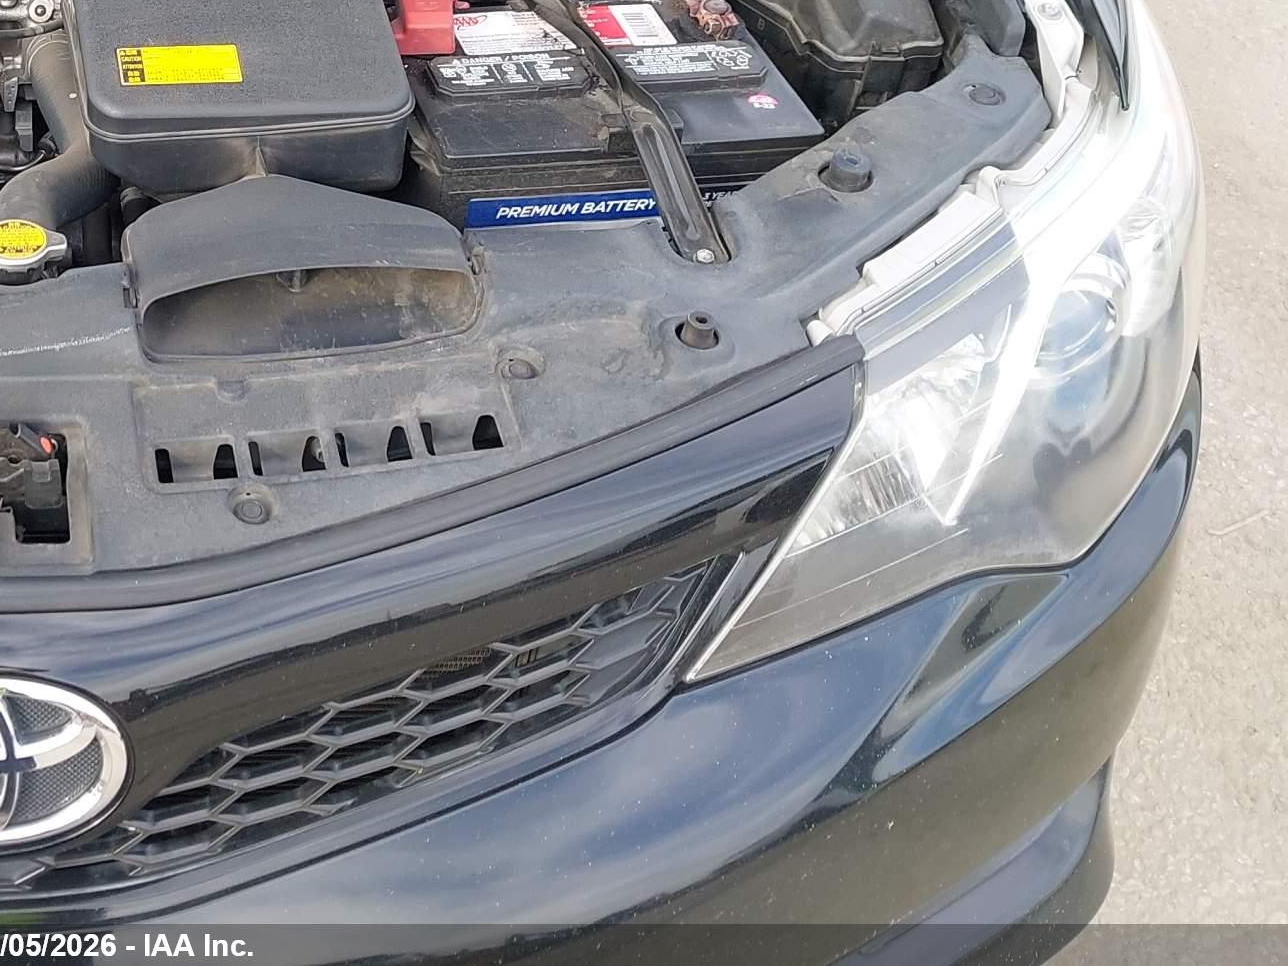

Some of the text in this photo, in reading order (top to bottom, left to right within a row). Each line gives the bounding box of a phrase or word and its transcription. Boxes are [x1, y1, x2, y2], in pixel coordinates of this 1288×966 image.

[461, 56, 502, 64] DANGER
[512, 53, 550, 61] POISON
[495, 197, 657, 220] PREMIUM BATTERY
